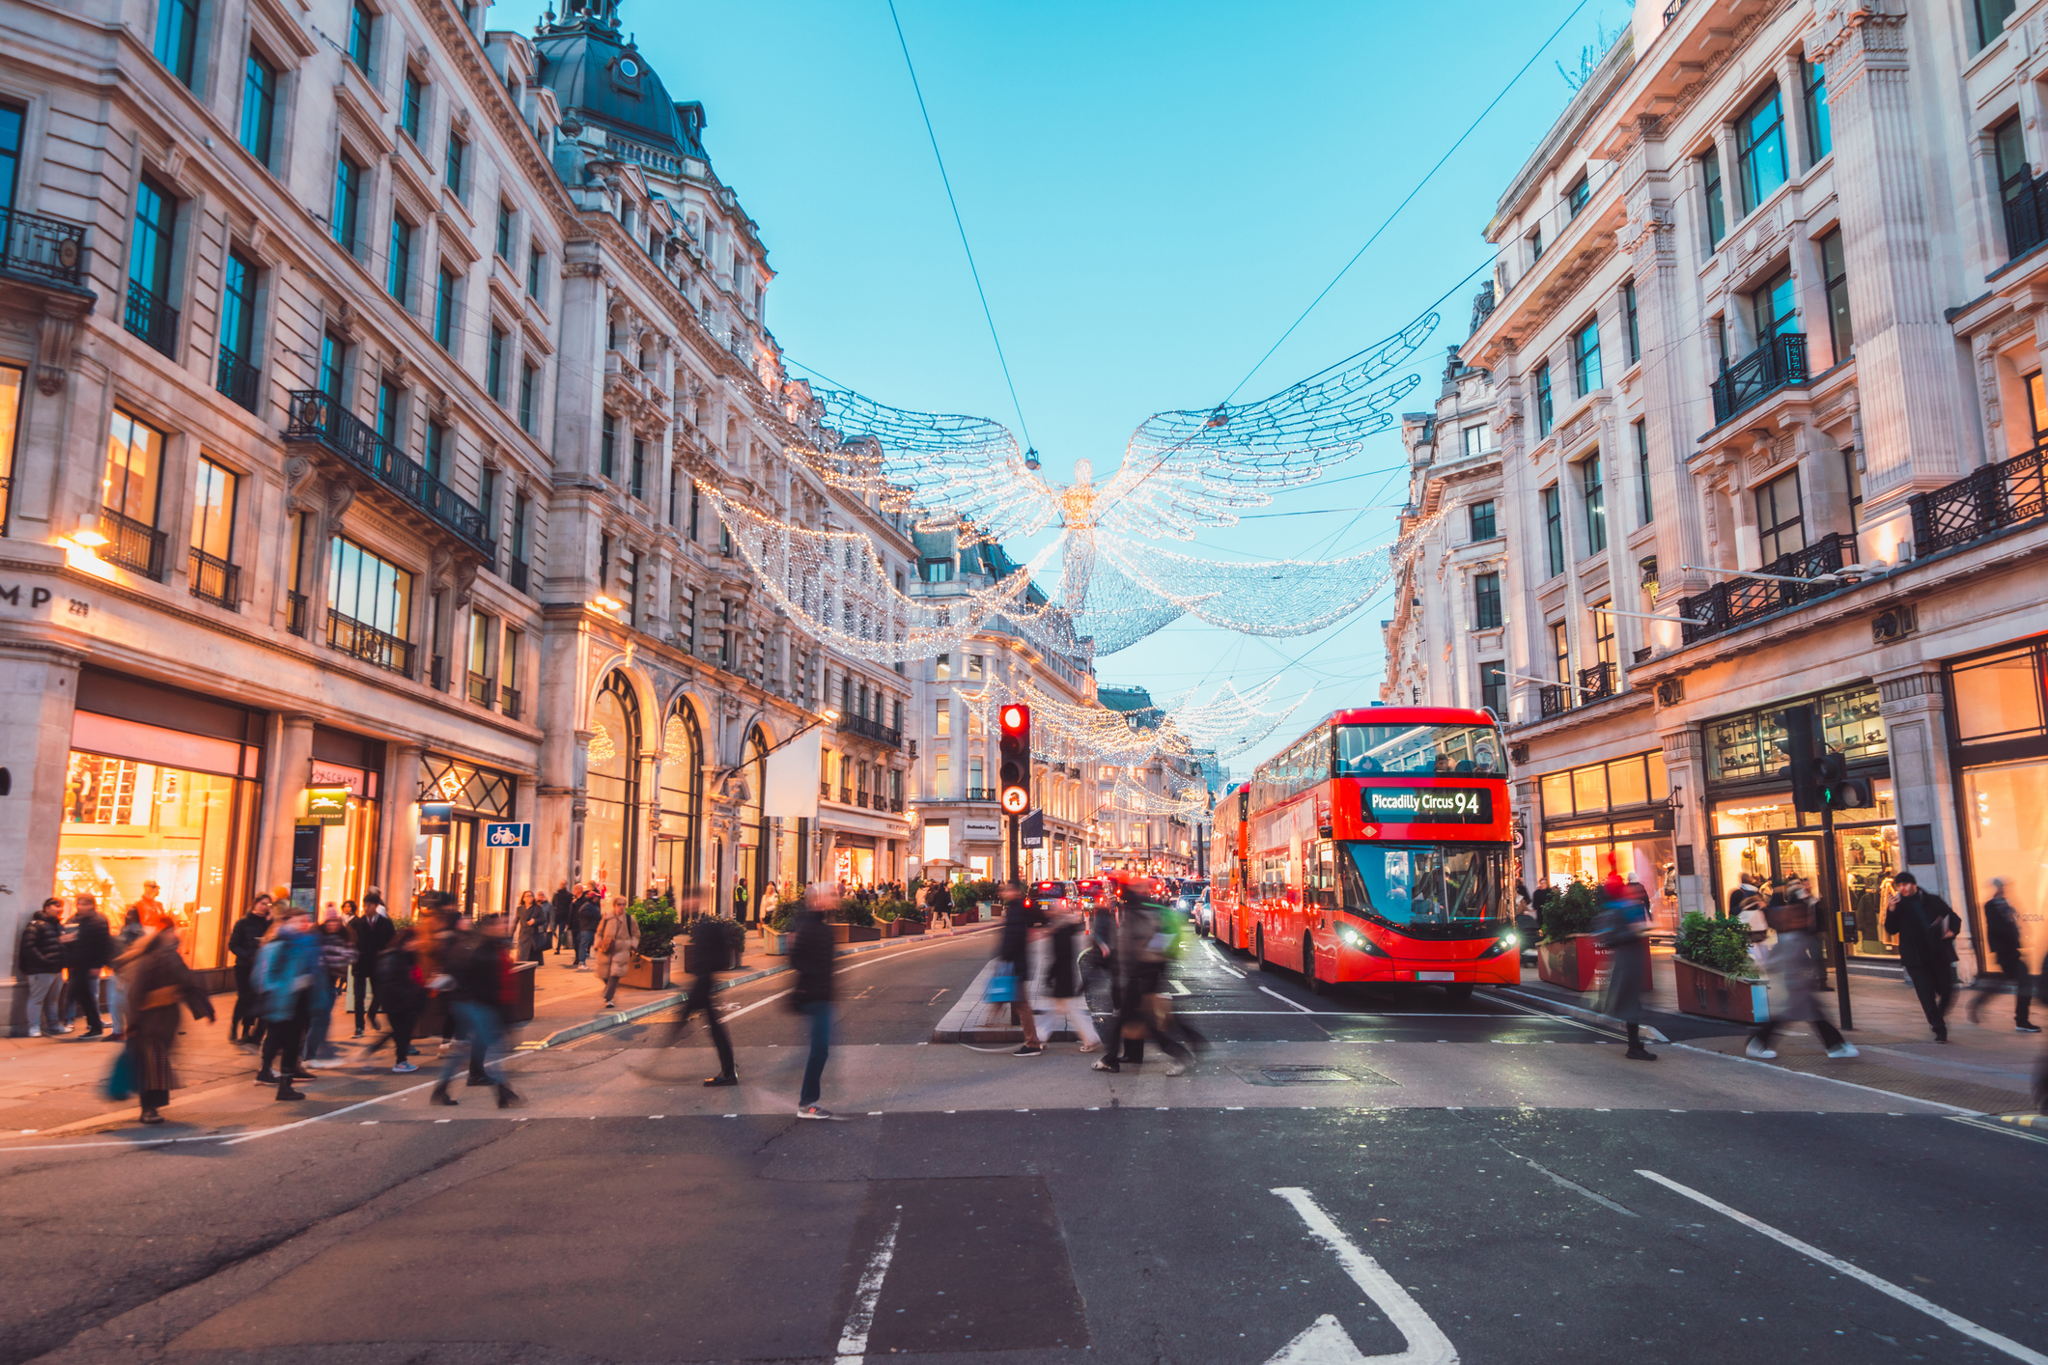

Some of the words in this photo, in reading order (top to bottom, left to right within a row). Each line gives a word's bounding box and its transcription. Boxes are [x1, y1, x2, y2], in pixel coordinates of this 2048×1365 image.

[1372, 794, 1420, 811] Piccadilly
[1422, 794, 1454, 809] Circus
[1455, 793, 1480, 814] 94
